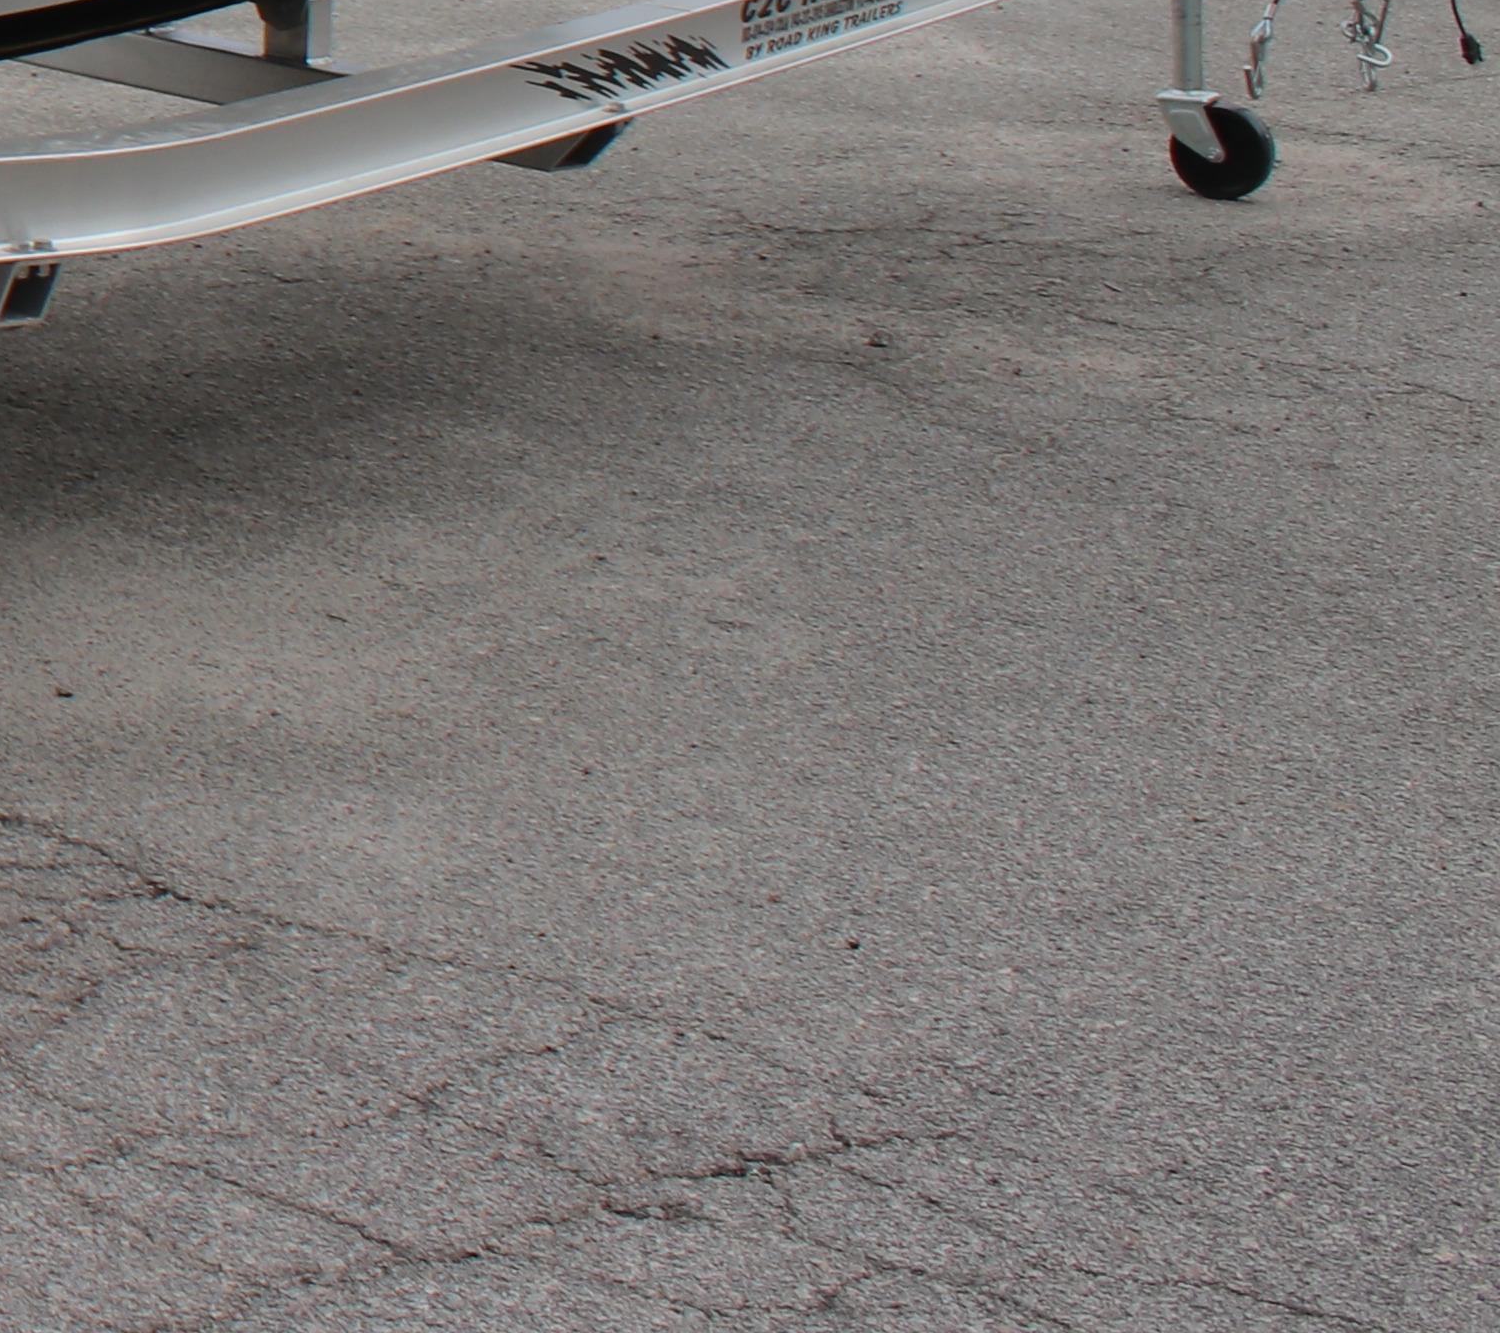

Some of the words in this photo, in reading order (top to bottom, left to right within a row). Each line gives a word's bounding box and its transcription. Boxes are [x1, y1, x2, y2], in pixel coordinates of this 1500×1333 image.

[746, 43, 762, 59] BY
[767, 31, 801, 55] ROAD
[807, 20, 840, 41] KING
[844, 1, 904, 30] TRAILERS
